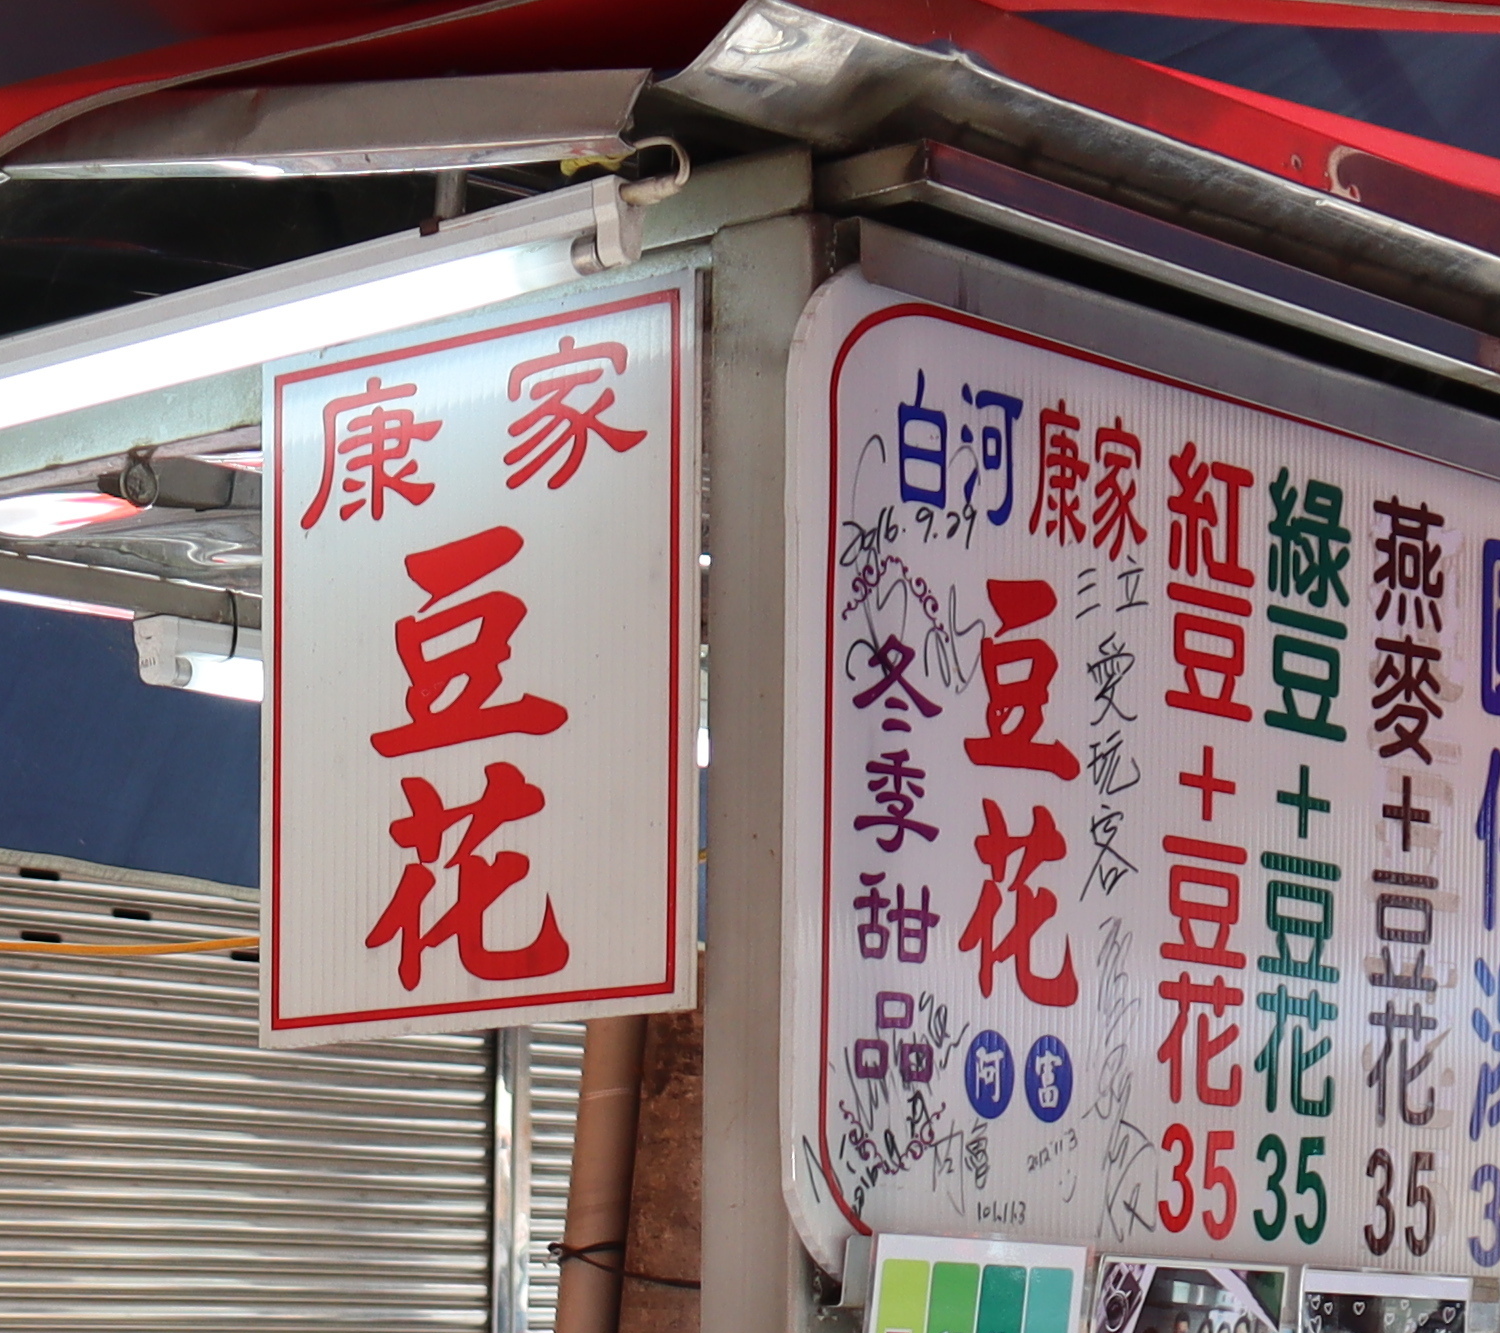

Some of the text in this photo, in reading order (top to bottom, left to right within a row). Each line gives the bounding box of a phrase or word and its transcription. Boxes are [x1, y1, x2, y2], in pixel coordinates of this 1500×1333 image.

[300, 336, 648, 530] 康家
[897, 368, 1148, 560] 白河康家
[364, 525, 570, 991] 豆花
[852, 633, 943, 1084] 冬季甜品
[957, 578, 1081, 1008] 豆花
[1156, 441, 1255, 1241] 紅豆+豆花 35
[1252, 467, 1352, 1245] 綠豆+豆花 35
[1363, 1147, 1437, 1257] 35
